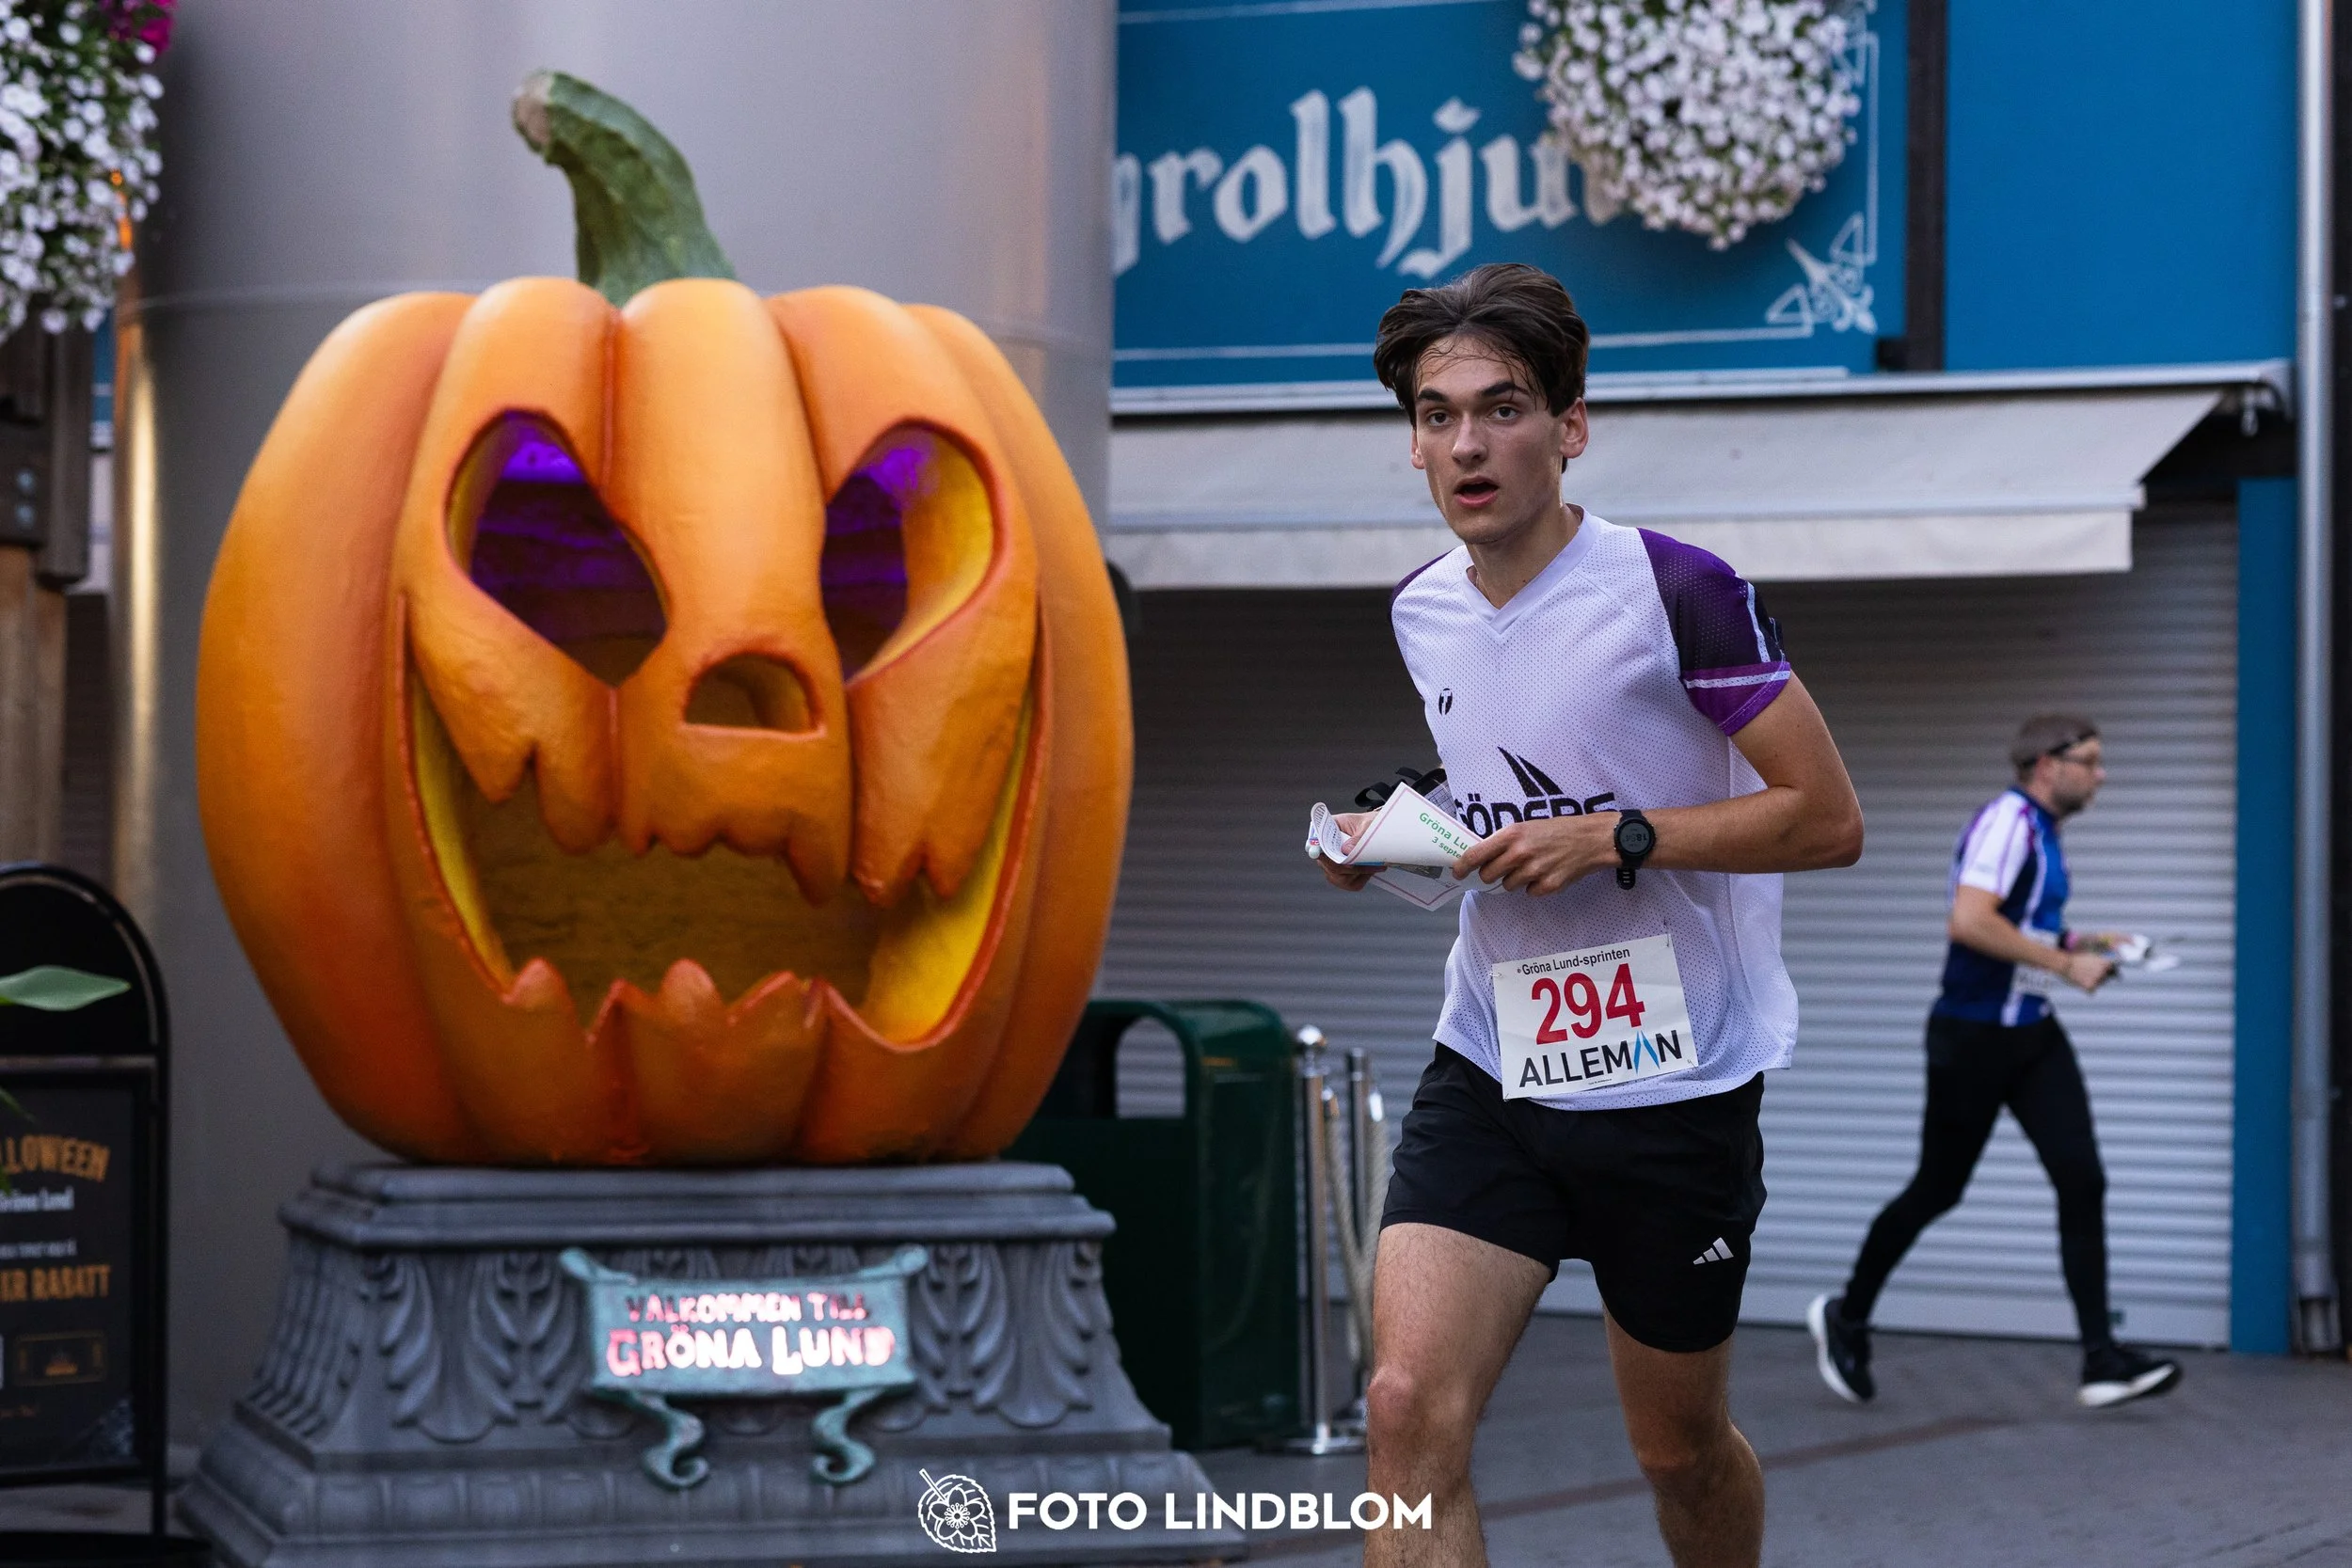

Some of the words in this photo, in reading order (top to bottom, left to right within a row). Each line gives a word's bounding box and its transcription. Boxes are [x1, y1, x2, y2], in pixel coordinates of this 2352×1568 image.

[1419, 813, 1453, 839] Gröna
[1453, 836, 1470, 850] Lu
[1521, 961, 1552, 975] Gröna
[1552, 947, 1630, 971] Lund-sprinten
[1531, 962, 1645, 1045] 294
[607, 1324, 762, 1376] GRÖNA
[771, 1325, 896, 1375] LUND
